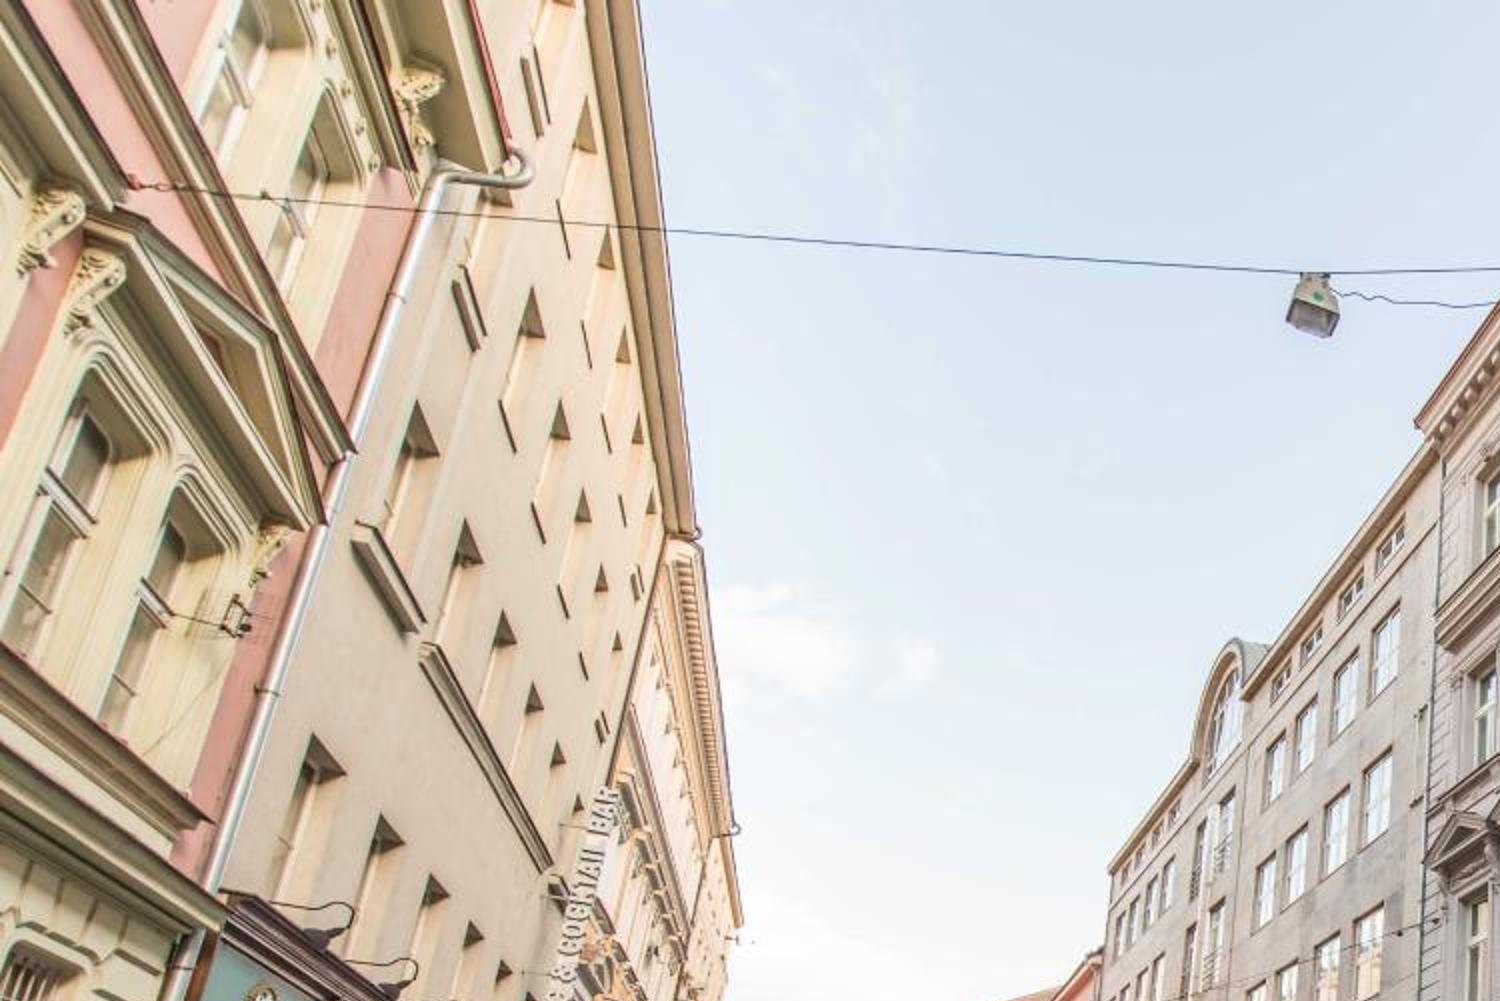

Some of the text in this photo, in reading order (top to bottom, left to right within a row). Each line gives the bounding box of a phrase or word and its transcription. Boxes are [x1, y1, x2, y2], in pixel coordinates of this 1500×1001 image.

[586, 786, 617, 836] BAR
[557, 848, 605, 957] COCKTAIL
[551, 961, 574, 984] &
